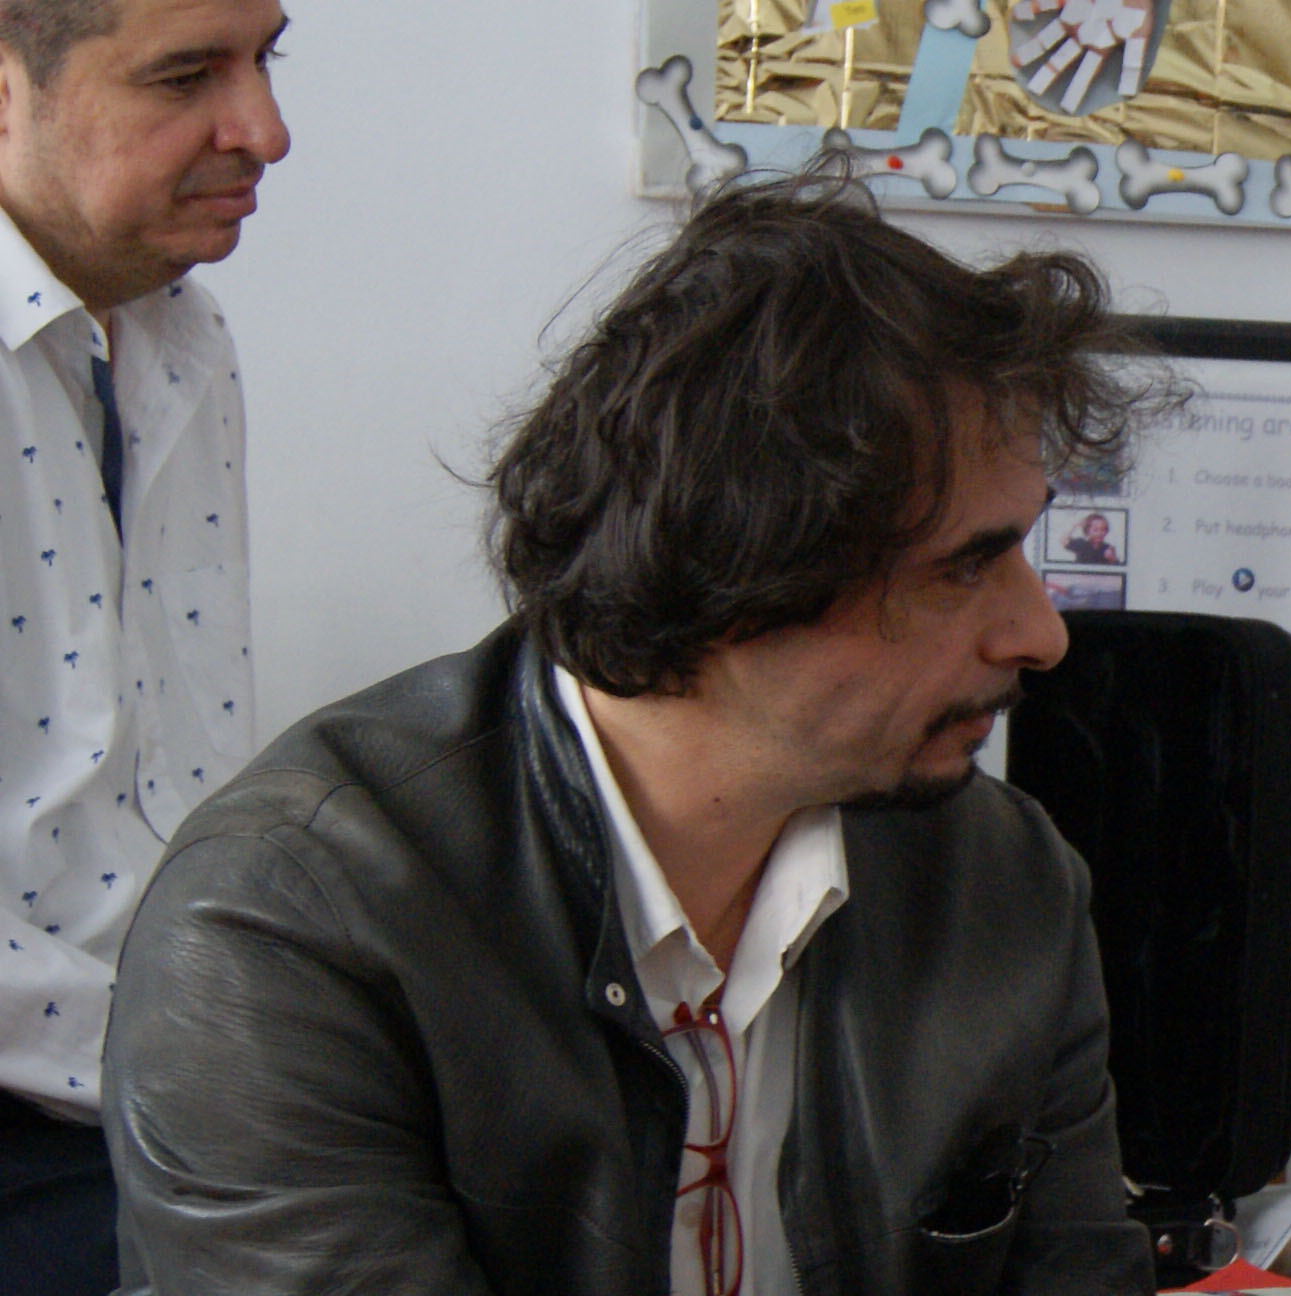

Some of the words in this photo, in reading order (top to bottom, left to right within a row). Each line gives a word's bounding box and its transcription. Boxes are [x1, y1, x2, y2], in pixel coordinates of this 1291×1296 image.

[1194, 469, 1249, 487] Choose
[1254, 474, 1263, 487] a
[1195, 518, 1221, 535] Put
[1192, 579, 1224, 599] Play
[1257, 585, 1291, 602] your
